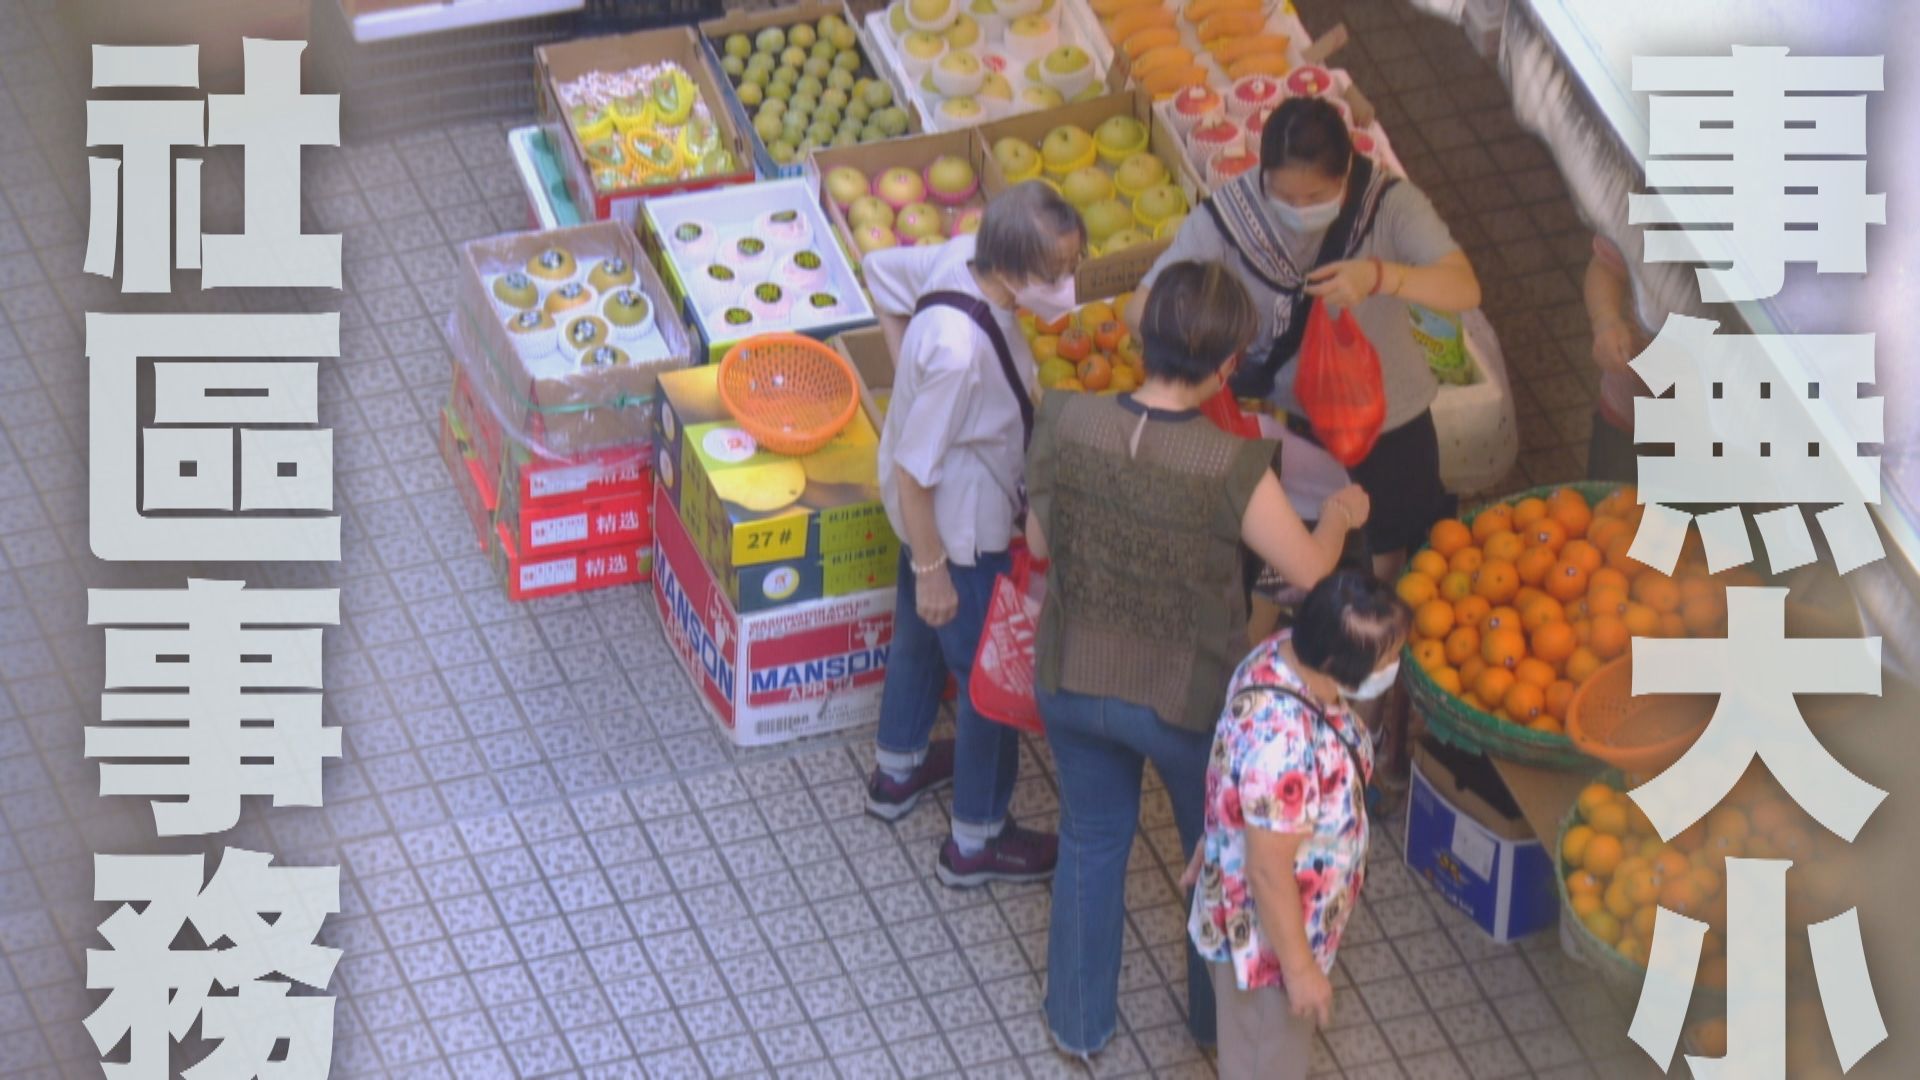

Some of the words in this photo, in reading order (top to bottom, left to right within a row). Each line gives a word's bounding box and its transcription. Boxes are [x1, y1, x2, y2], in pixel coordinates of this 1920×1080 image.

[597, 510, 640, 535] 精选
[747, 530, 773, 550] 27
[779, 528, 792, 544] #
[585, 554, 628, 579] 精选
[655, 537, 733, 702] MANSON
[751, 646, 891, 693] MANSON
